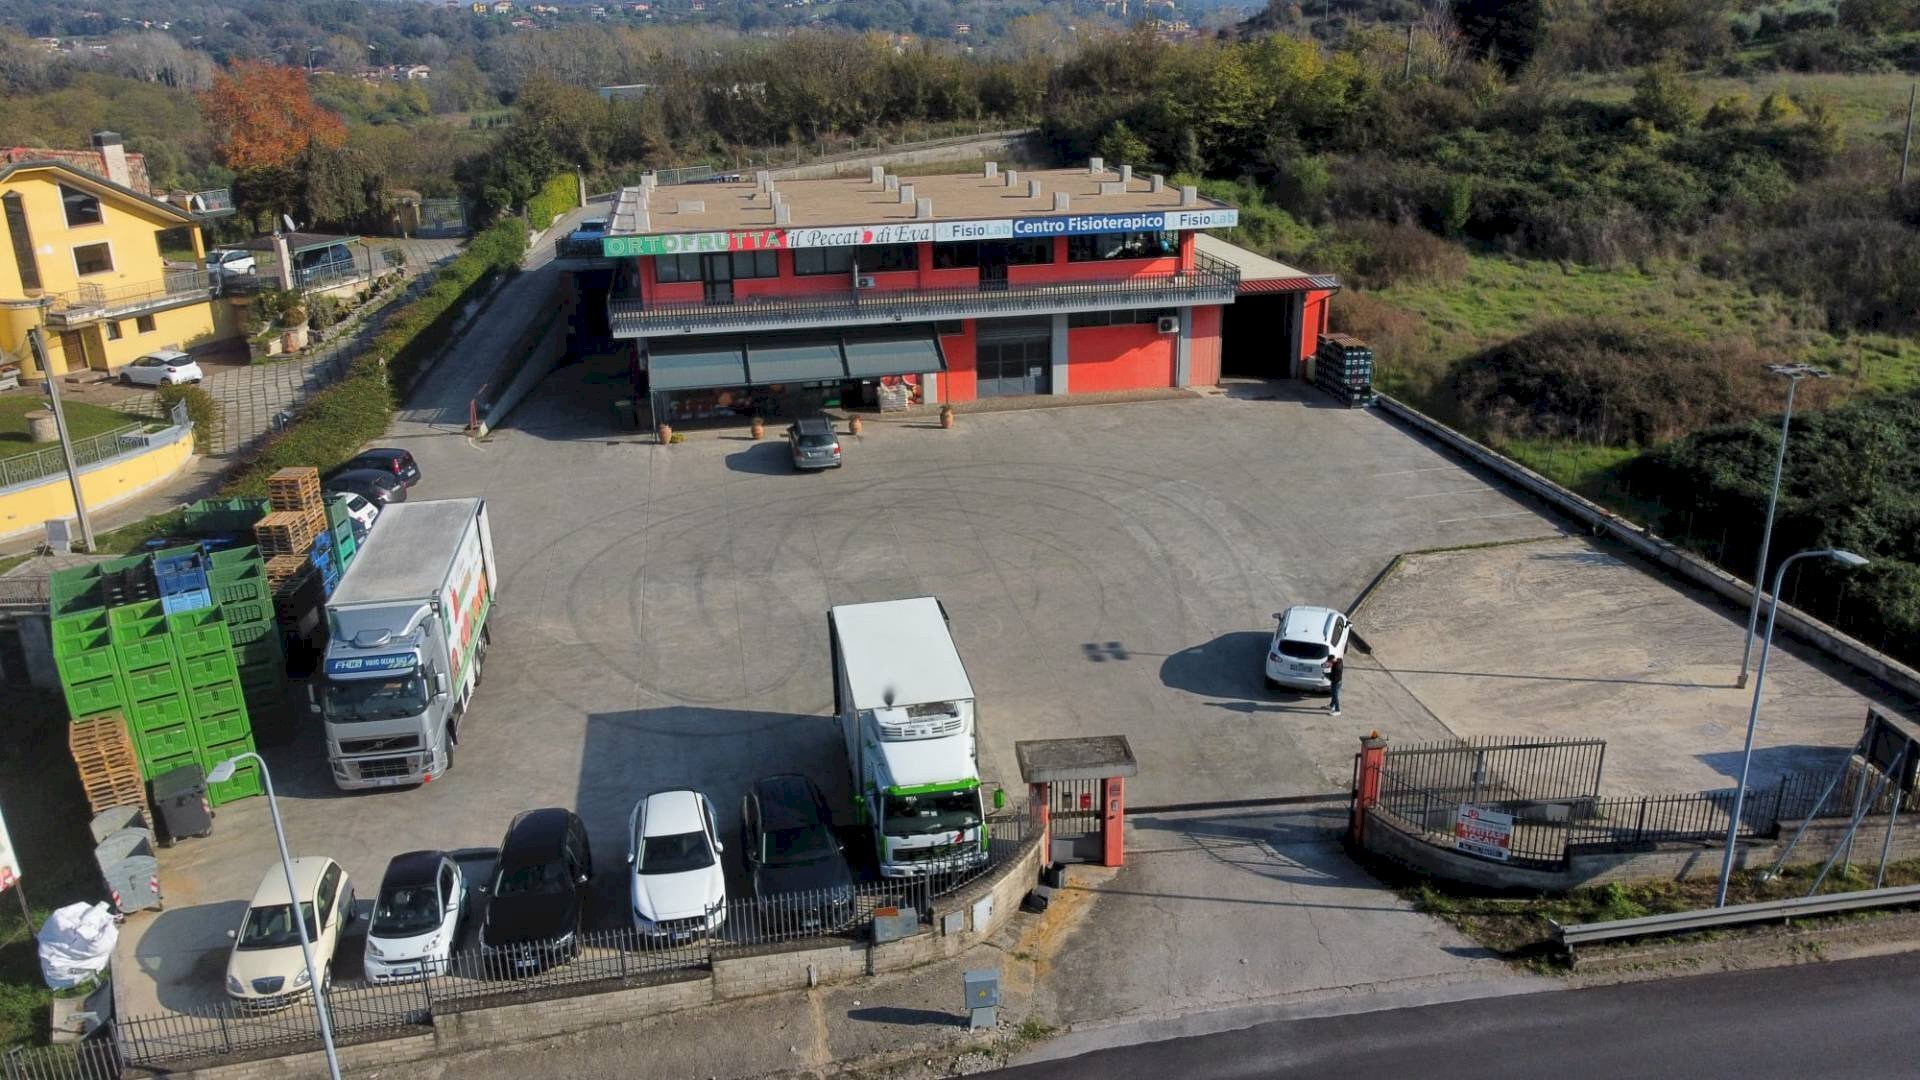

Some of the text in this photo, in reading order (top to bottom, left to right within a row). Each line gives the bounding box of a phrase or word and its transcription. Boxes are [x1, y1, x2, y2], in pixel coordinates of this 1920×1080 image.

[1013, 215, 1163, 234] Centro Fisioterapico
[1180, 211, 1236, 226] FisioLab
[875, 228, 892, 243] di
[894, 225, 930, 242] Eva
[951, 221, 1011, 238] FisioLab
[607, 231, 781, 256] ORTOFRUTTA
